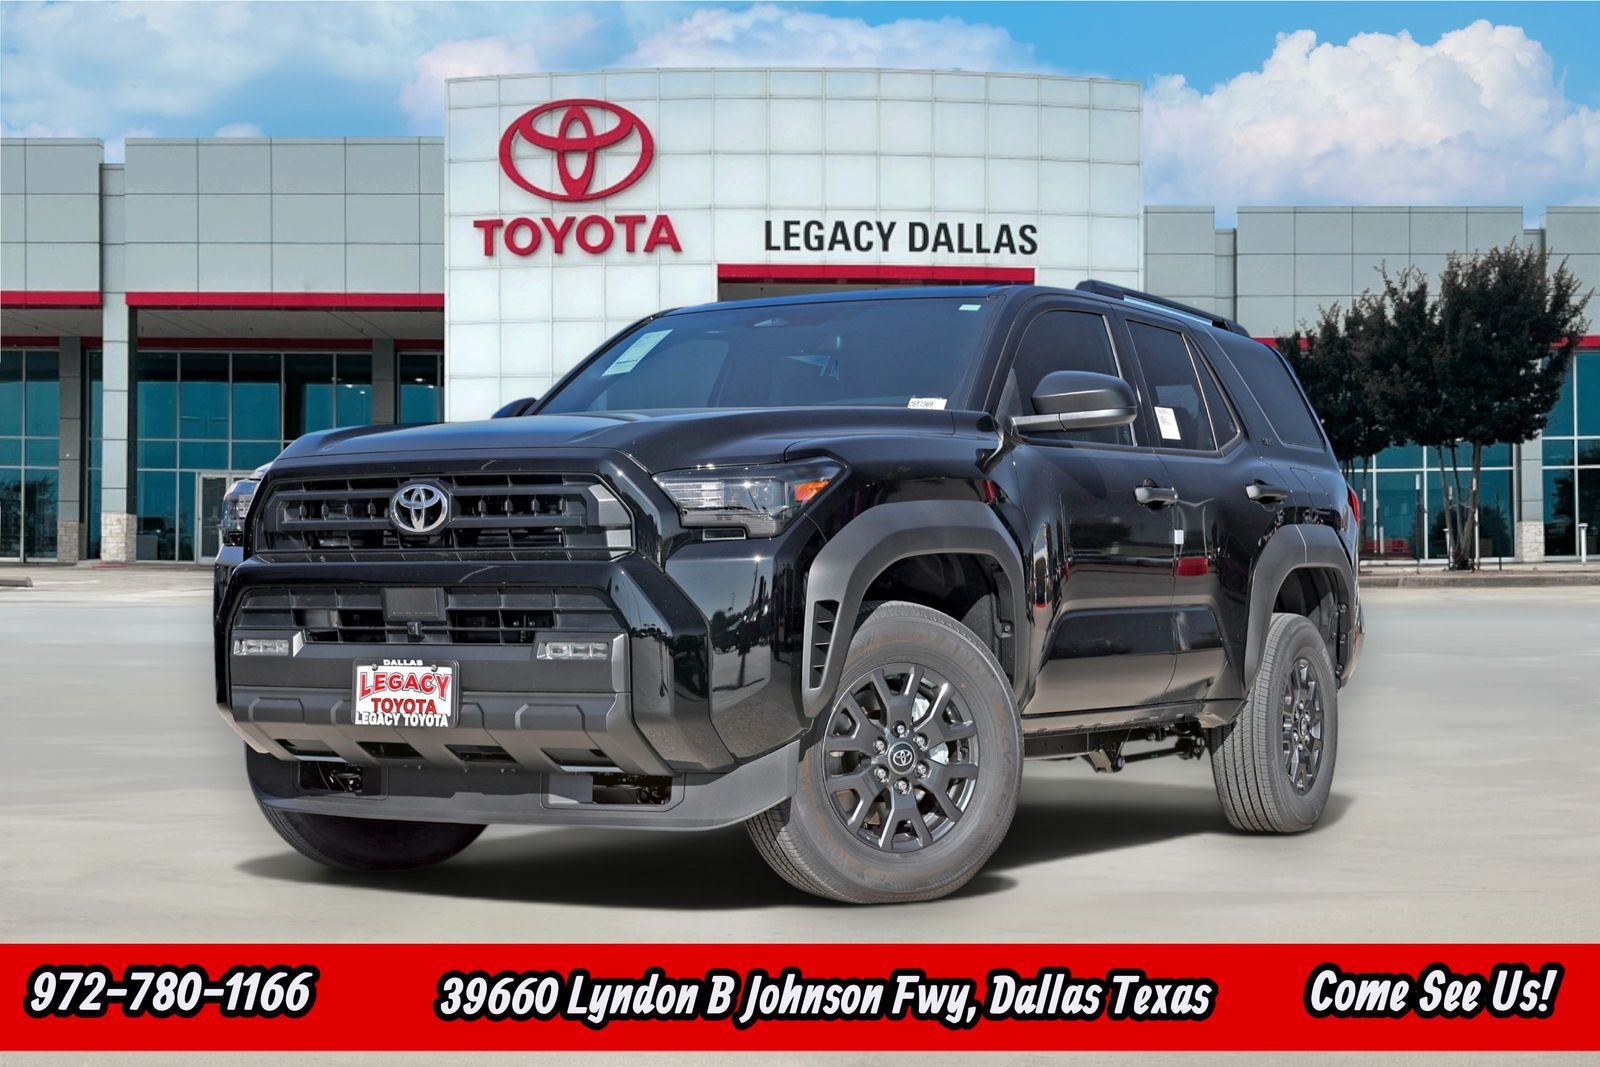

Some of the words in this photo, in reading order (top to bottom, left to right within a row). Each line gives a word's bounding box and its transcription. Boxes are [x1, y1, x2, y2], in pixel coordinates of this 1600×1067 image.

[474, 214, 682, 256] TOYOTA
[765, 221, 897, 252] LEGACY
[908, 222, 1038, 254] DALLAS
[360, 672, 451, 701] LEGACY
[355, 711, 400, 725] LEGACY
[402, 713, 449, 727] TOYOTA
[371, 698, 437, 714] TOYOTA
